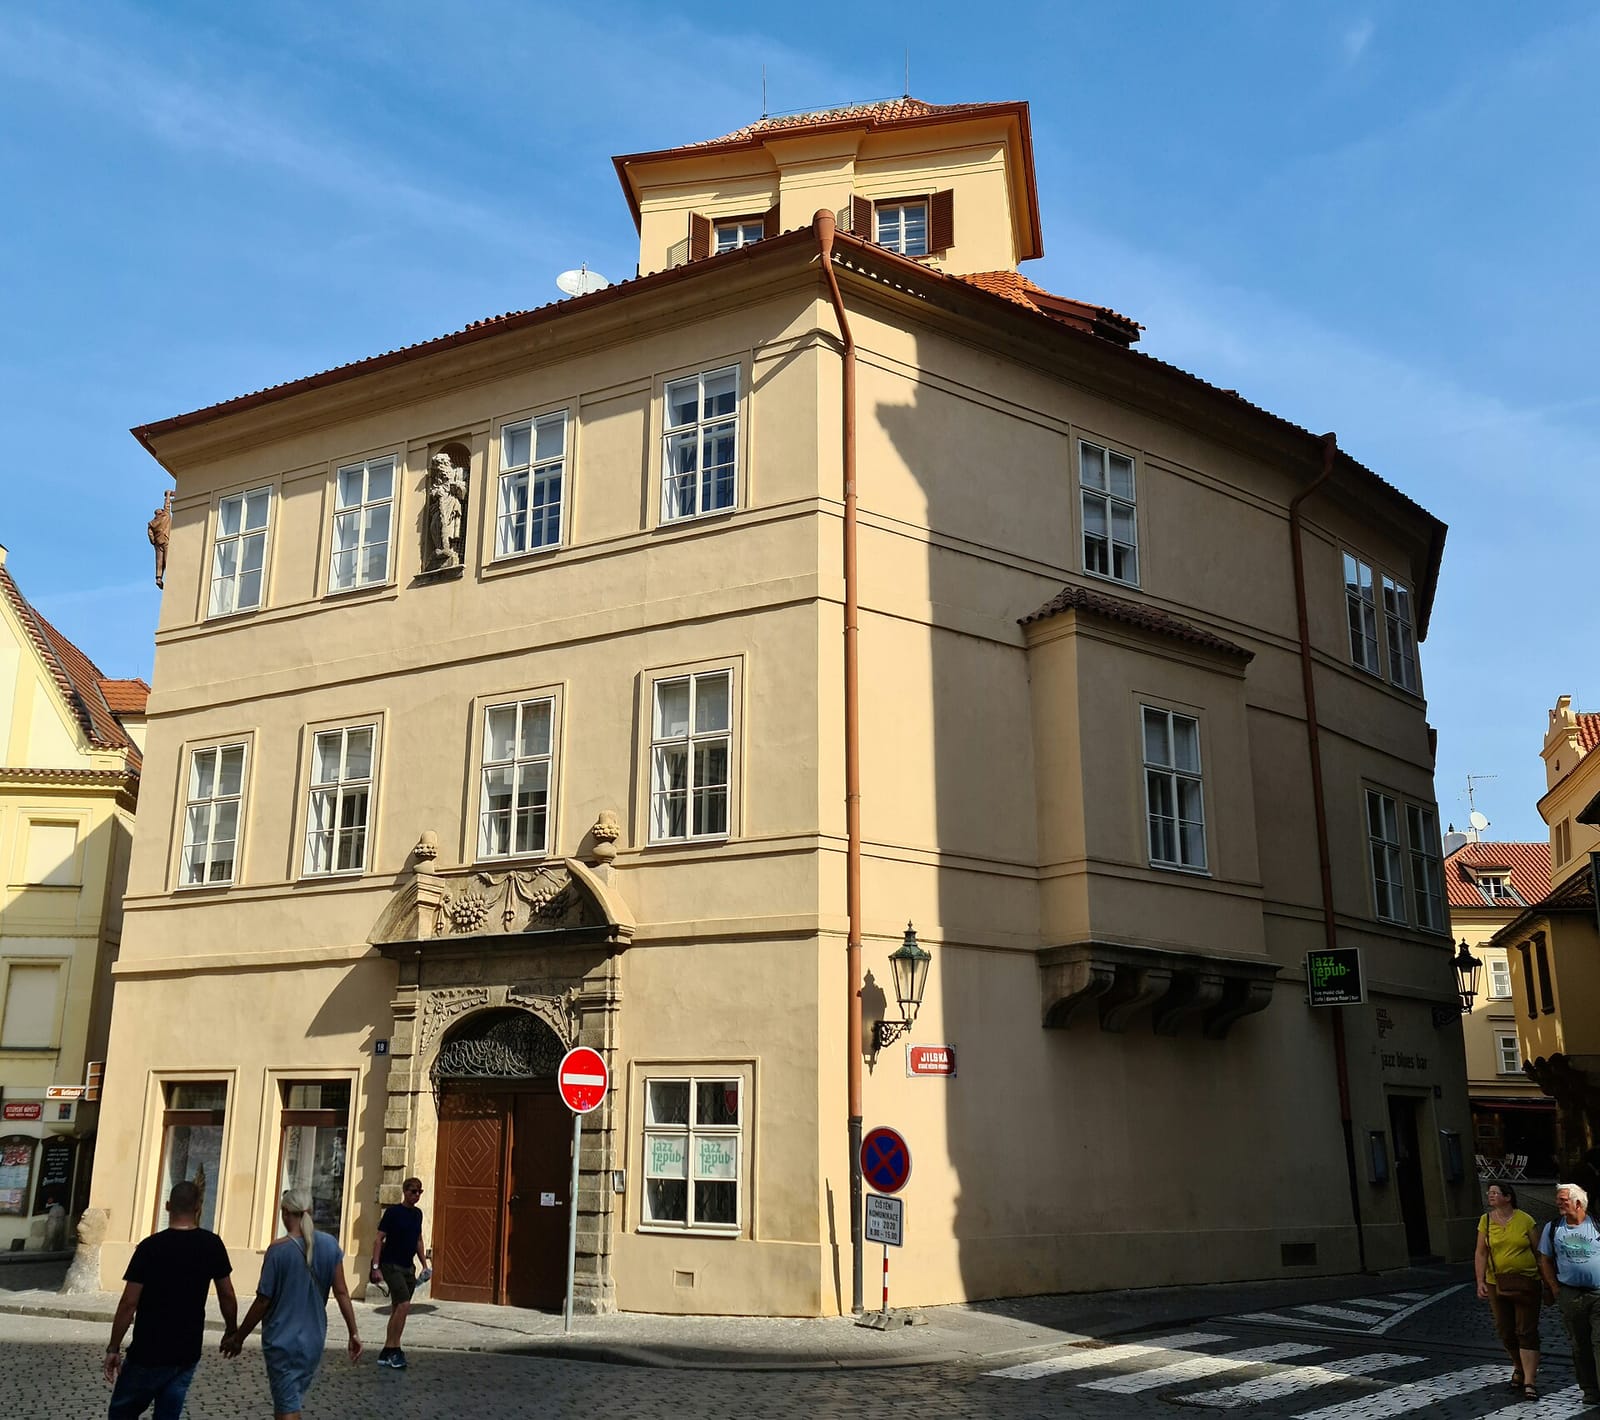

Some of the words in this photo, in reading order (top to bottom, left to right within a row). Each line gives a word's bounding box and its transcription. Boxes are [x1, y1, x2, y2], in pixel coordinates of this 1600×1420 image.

[1311, 954, 1335, 968] jazz
[653, 1137, 674, 1153] jazz
[701, 1140, 722, 1154] jazz
